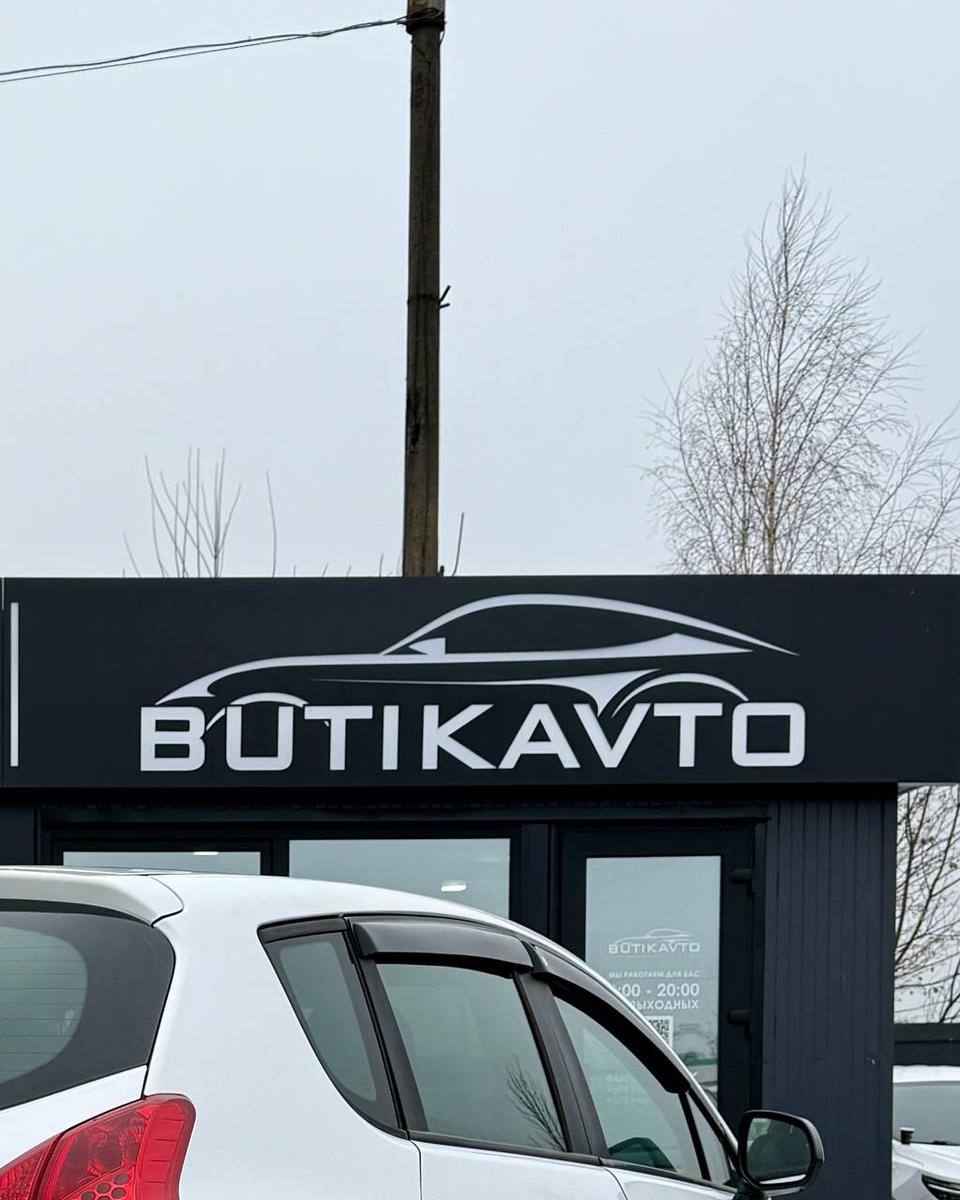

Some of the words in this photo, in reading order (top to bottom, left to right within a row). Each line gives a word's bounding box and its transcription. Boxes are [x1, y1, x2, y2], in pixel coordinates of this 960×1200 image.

[140, 702, 806, 773] BUTIKAVTO
[608, 942, 700, 954] BUTIKAVTO
[613, 983, 641, 998] :00
[657, 983, 700, 997] 20:00
